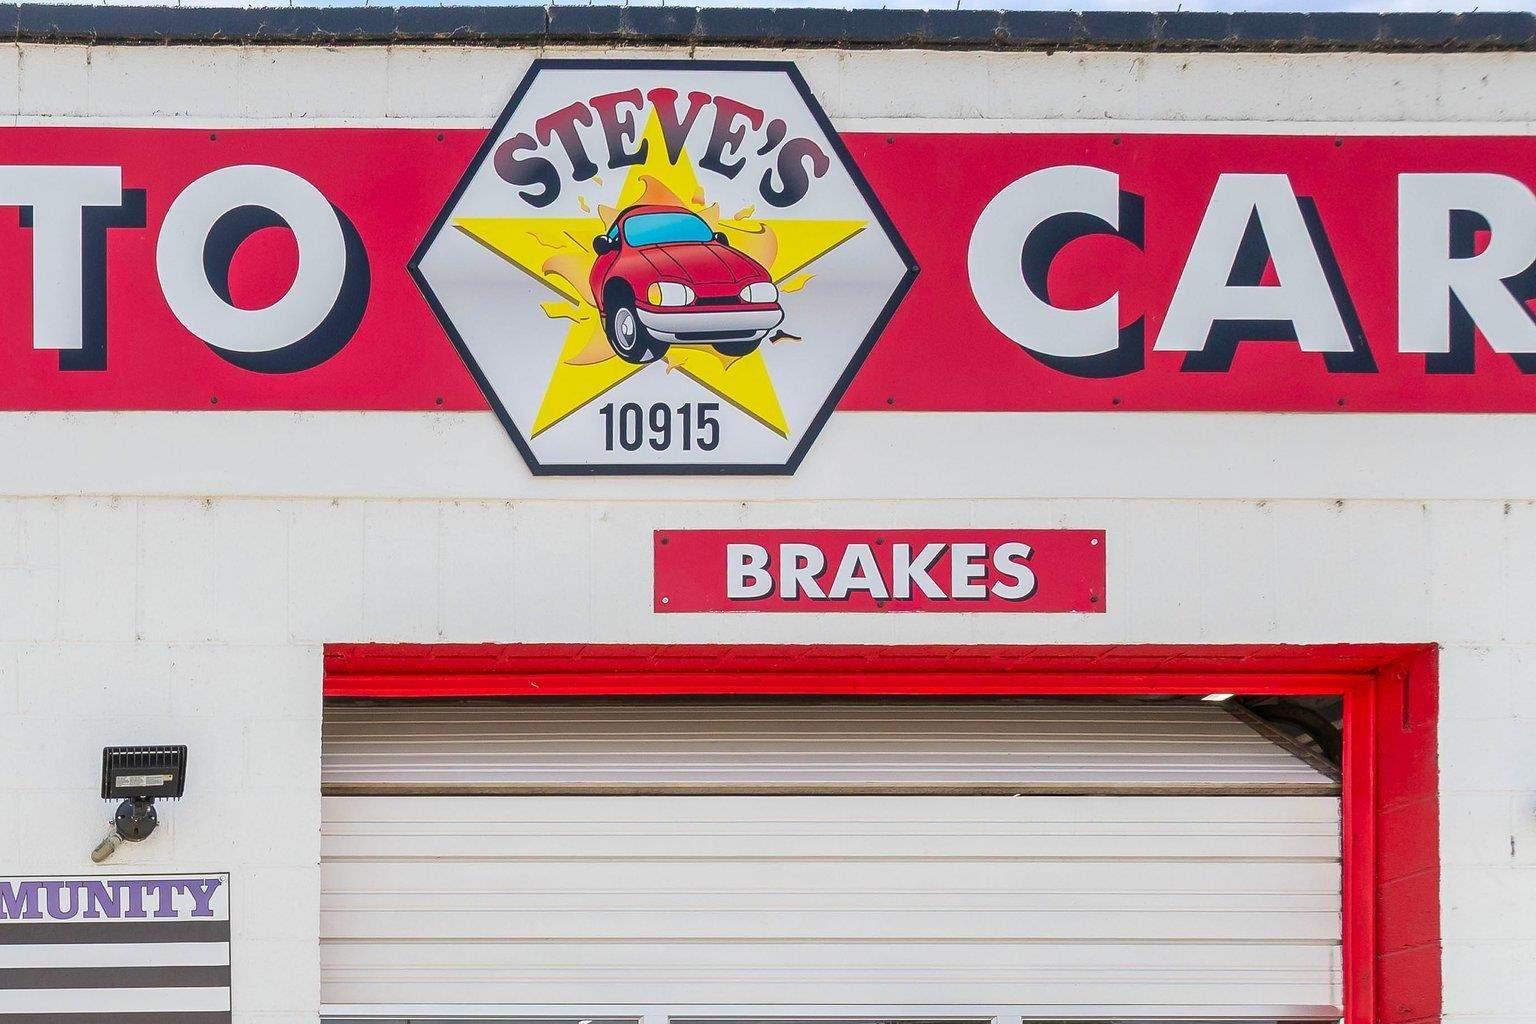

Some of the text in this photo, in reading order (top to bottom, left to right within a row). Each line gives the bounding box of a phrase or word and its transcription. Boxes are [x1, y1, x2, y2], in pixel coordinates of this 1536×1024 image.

[493, 87, 830, 209] STEVE'S
[967, 164, 1536, 362] CAR
[599, 402, 721, 452] 10915
[726, 542, 1038, 601] BRAKES
